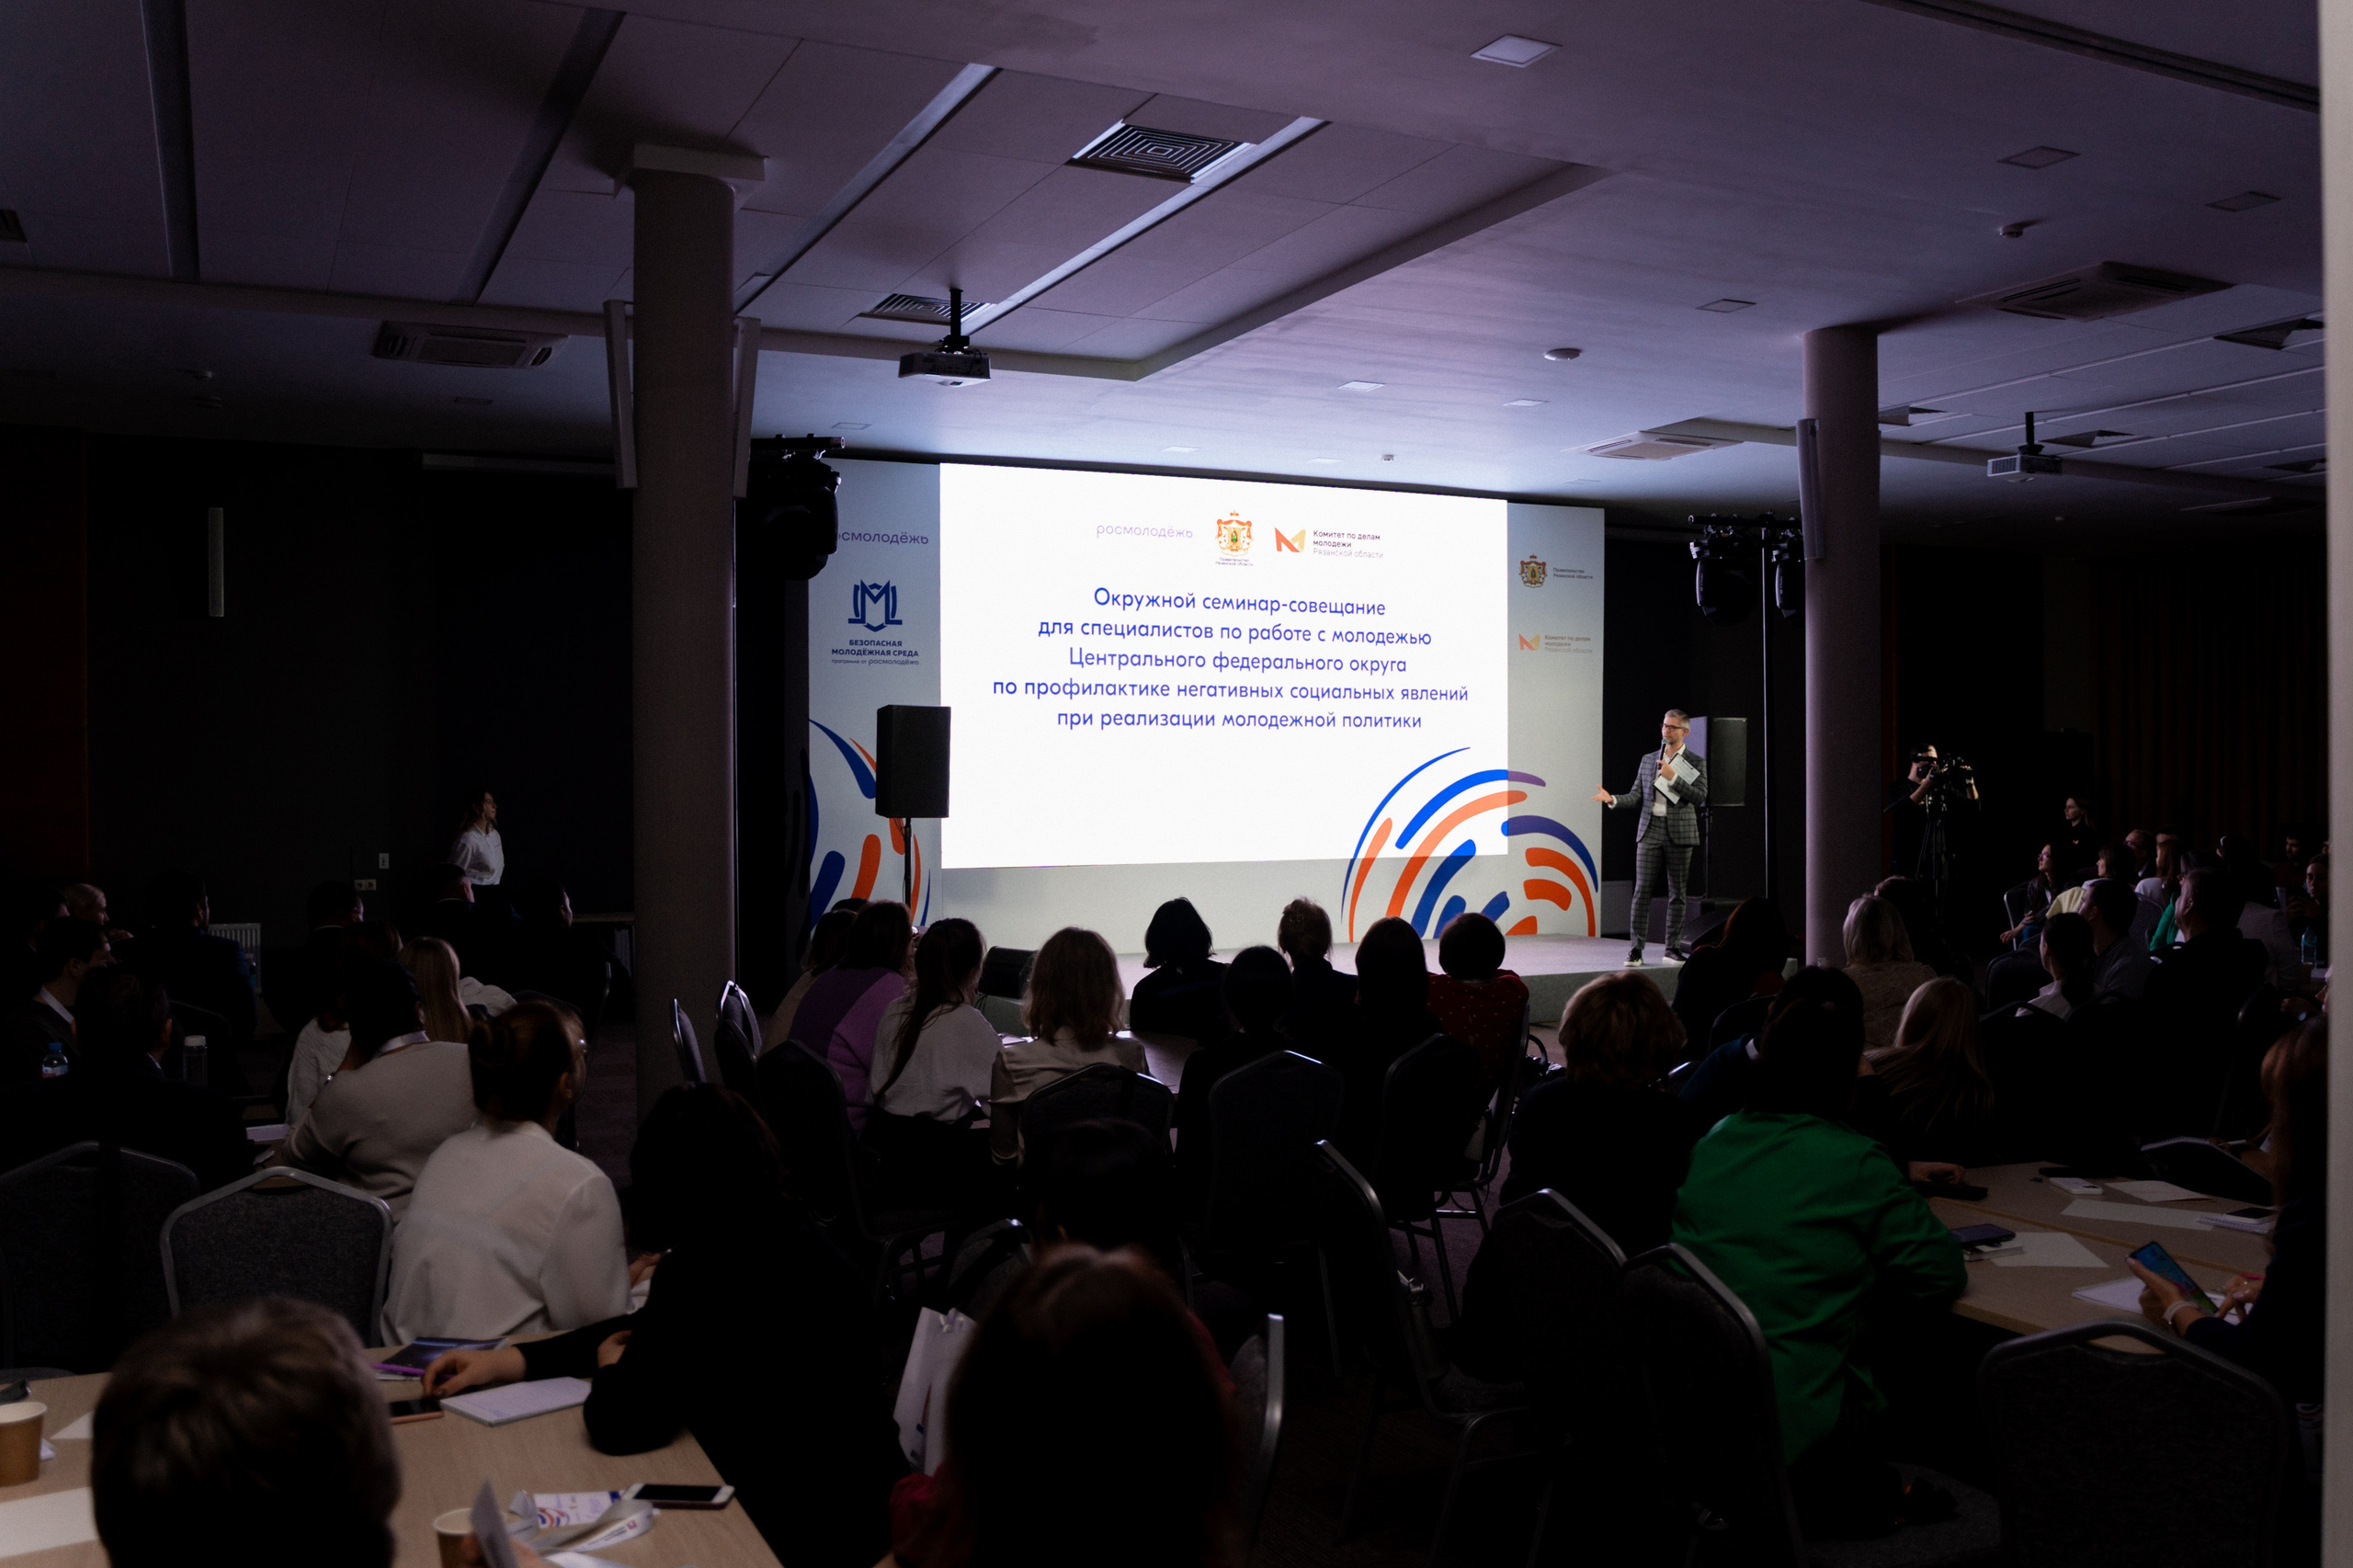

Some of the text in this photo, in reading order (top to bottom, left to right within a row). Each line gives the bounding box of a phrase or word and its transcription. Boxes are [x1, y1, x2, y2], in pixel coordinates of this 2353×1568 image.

[838, 531, 928, 545] смолодёжь
[1097, 526, 1192, 538] росмолодёжь
[1313, 548, 1352, 556] Рязанской
[1094, 587, 1385, 617] Окружной семинар-совещание
[1039, 621, 1431, 646] для специалистов по работе с молодежью
[832, 648, 891, 656] МОЛОДЁЖНАЯ
[1070, 647, 1406, 676] Центрального федерального округа
[994, 677, 1468, 701] по профилактике негативных социальных явлений
[1058, 711, 1421, 731] при реализации молодежной политики
